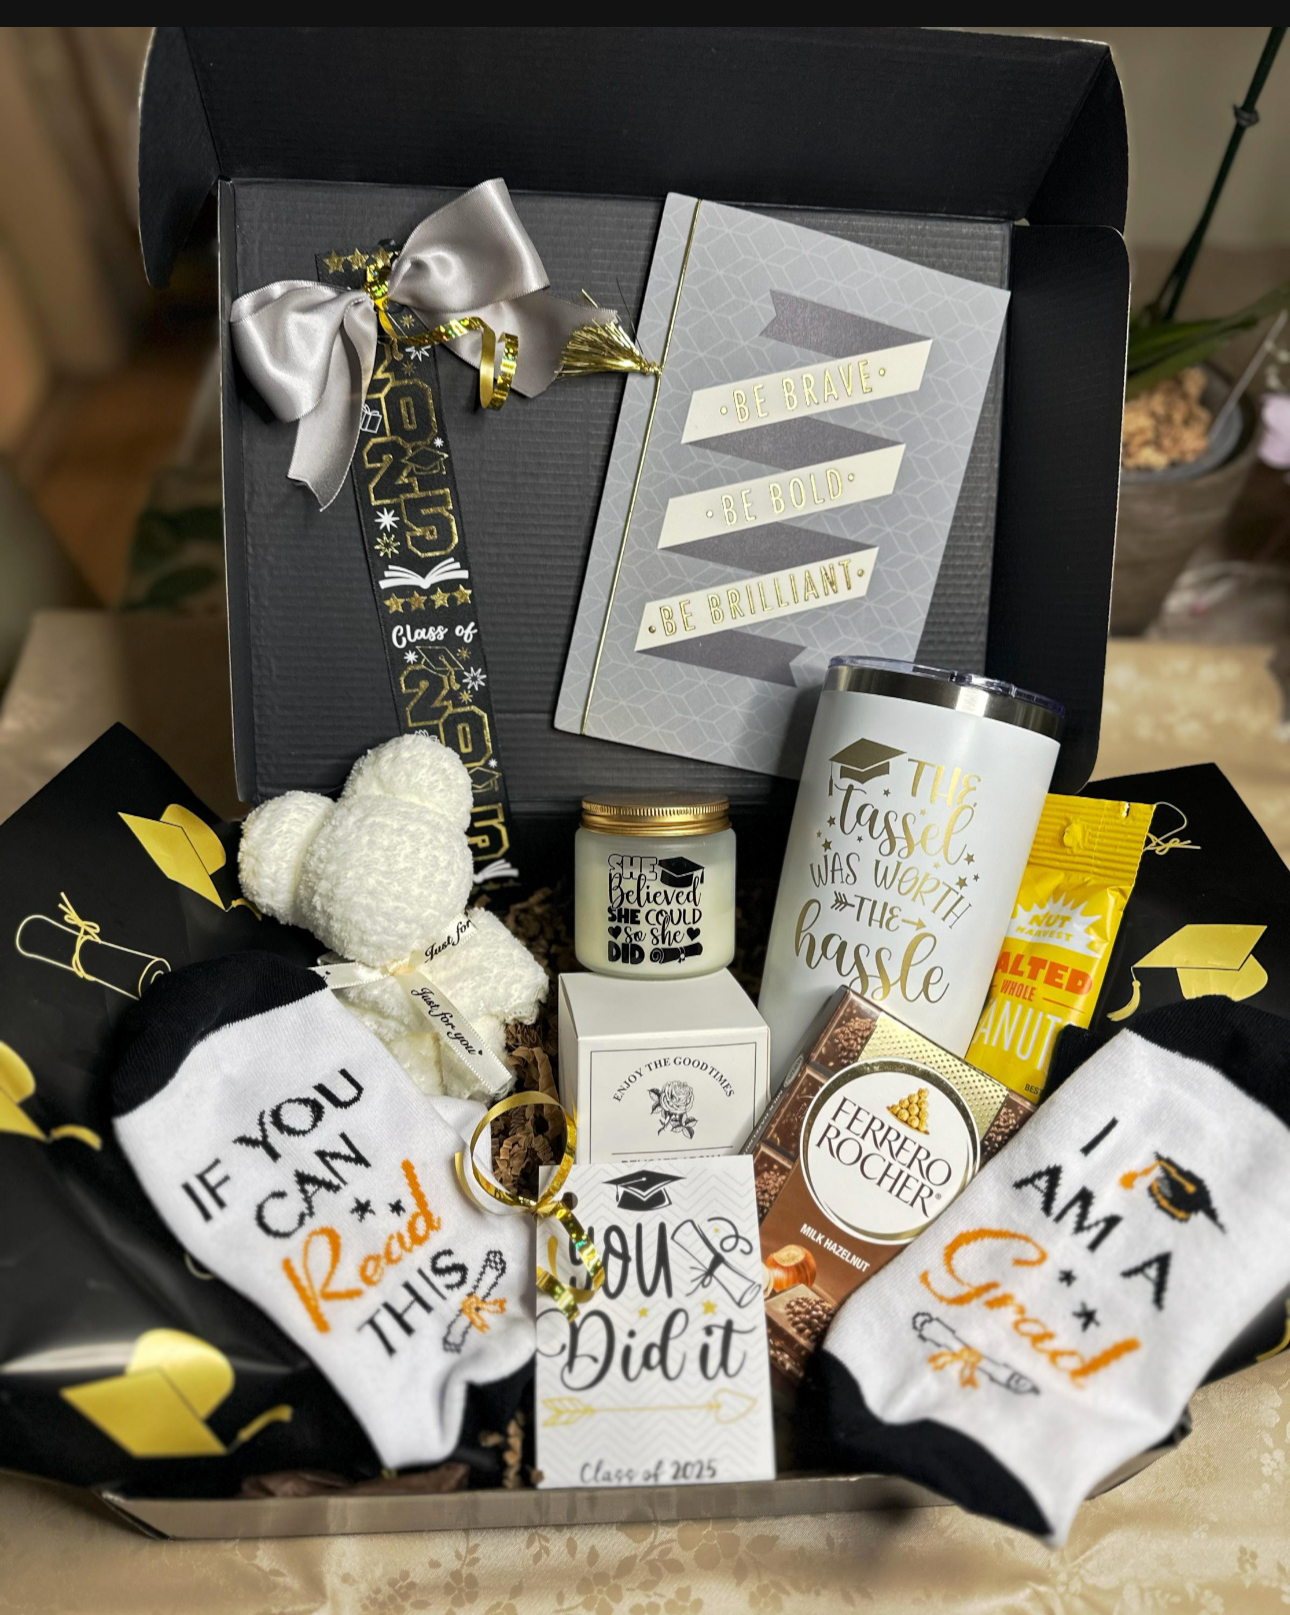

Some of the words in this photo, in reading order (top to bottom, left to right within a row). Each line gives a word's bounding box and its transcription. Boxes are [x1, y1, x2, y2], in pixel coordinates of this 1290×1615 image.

[731, 384, 769, 423] BE
[782, 359, 873, 411] BRAVE
[721, 489, 757, 527] BE
[769, 468, 843, 515] BOLD
[659, 599, 696, 637] BE
[707, 558, 853, 625] BRILLIANT
[391, 624, 449, 649] Class
[454, 621, 478, 644] of
[907, 757, 982, 807] THE
[607, 872, 702, 909] Believed
[608, 853, 658, 881] SHE
[809, 852, 861, 888] WAS
[873, 858, 973, 930] WORTH
[607, 906, 641, 925] SHE
[644, 908, 703, 926] COULD
[650, 914, 684, 947] she
[853, 894, 903, 932] THE
[1014, 926, 1074, 943] HARVEST
[1028, 911, 1072, 930] NUT
[424, 935, 453, 963] Just
[451, 919, 472, 946] for
[607, 940, 646, 965] DID
[794, 898, 950, 1004] hassle
[995, 950, 1093, 996] ALTED
[1000, 979, 1036, 1002] WHOLE
[410, 987, 440, 1011] Just
[428, 1007, 456, 1032] for
[446, 1030, 477, 1056] you
[972, 998, 1063, 1071] ANUT
[612, 1068, 645, 1103] ENJOY
[645, 1056, 671, 1073] THE
[673, 1056, 709, 1072] GOOD
[708, 1066, 735, 1098] TIMES
[181, 1157, 232, 1223] IF
[231, 1067, 365, 1164] YOU
[829, 1096, 953, 1188] FERRERO
[1079, 1116, 1119, 1157] I
[254, 1132, 373, 1240] CAN
[281, 1158, 443, 1334] Read
[799, 1223, 825, 1245] MILK
[823, 1239, 871, 1273] HAZELNUT
[1012, 1163, 1124, 1253] AM
[1119, 1250, 1173, 1313] A
[356, 1248, 471, 1357] THIS
[918, 1227, 1142, 1390] Grad
[536, 1307, 690, 1392] Did
[699, 1318, 758, 1381] it
[580, 1459, 631, 1484] Class
[641, 1459, 665, 1484] of
[671, 1457, 719, 1481] 2025
